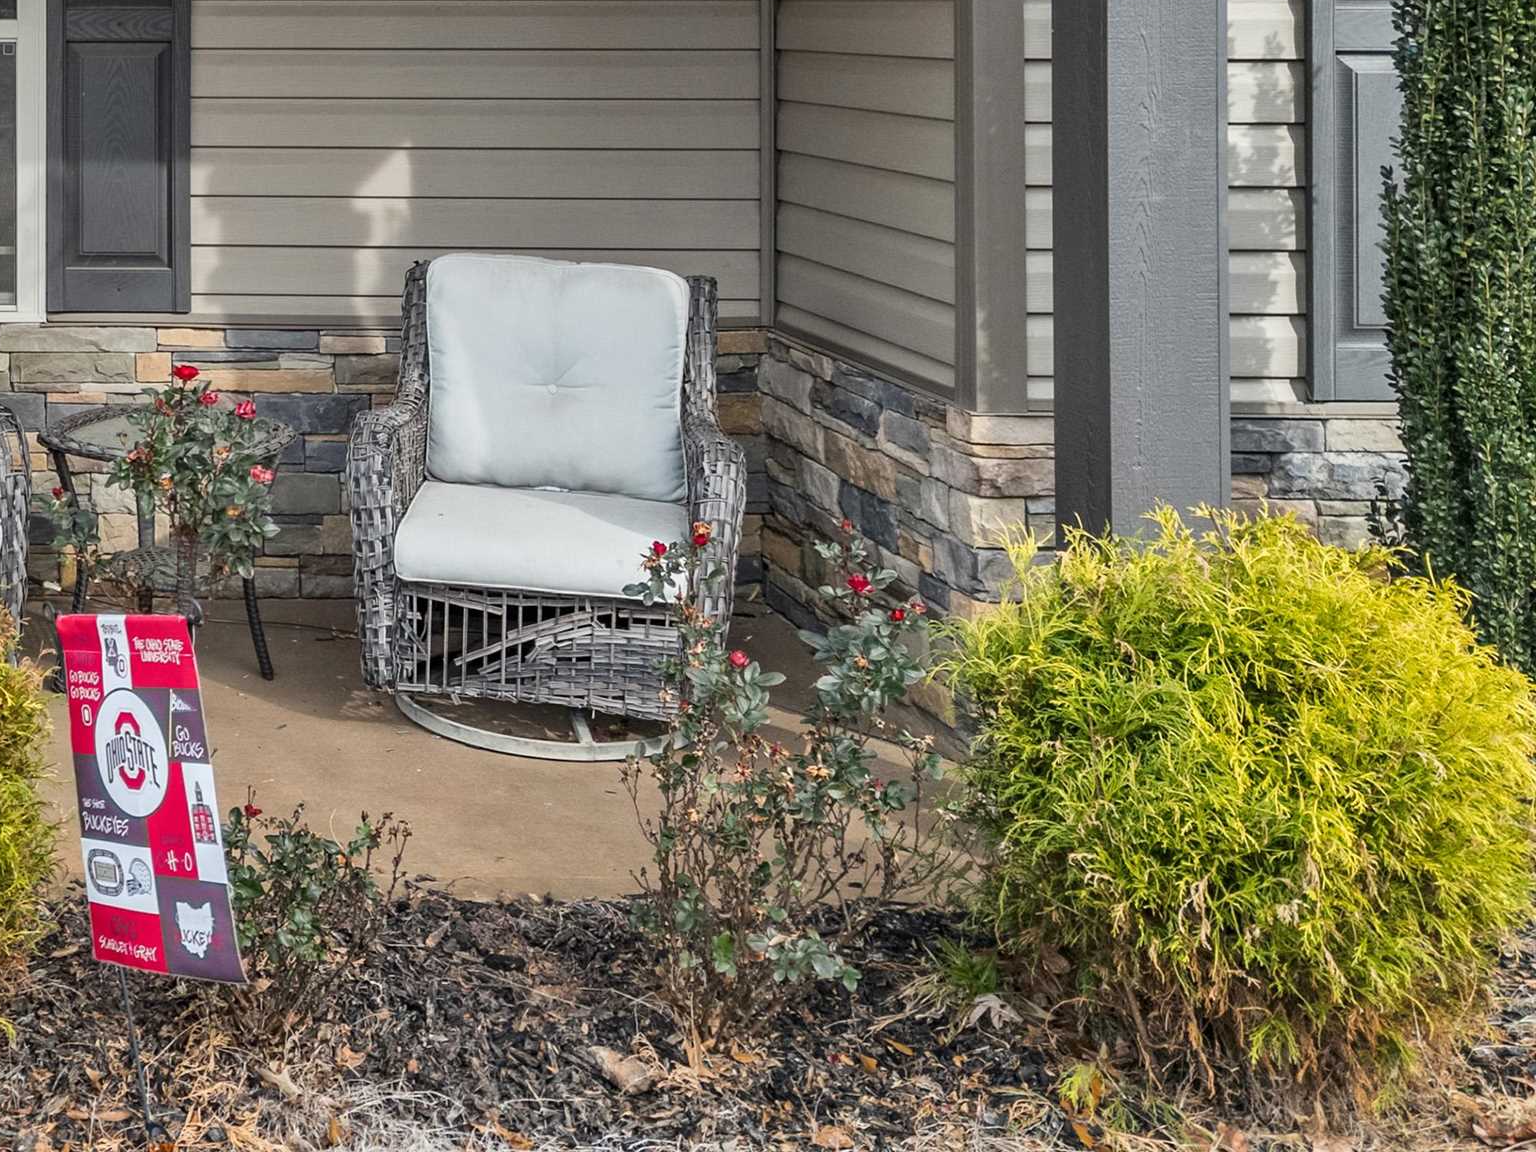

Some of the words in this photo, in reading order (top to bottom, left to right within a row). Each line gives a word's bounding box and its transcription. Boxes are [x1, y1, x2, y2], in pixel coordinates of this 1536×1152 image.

[78, 670, 99, 685] BUCKS
[79, 686, 101, 701] BUCKS
[175, 725, 190, 741] GO
[172, 740, 204, 759] BUCKS
[82, 811, 129, 837] BUCKEYES
